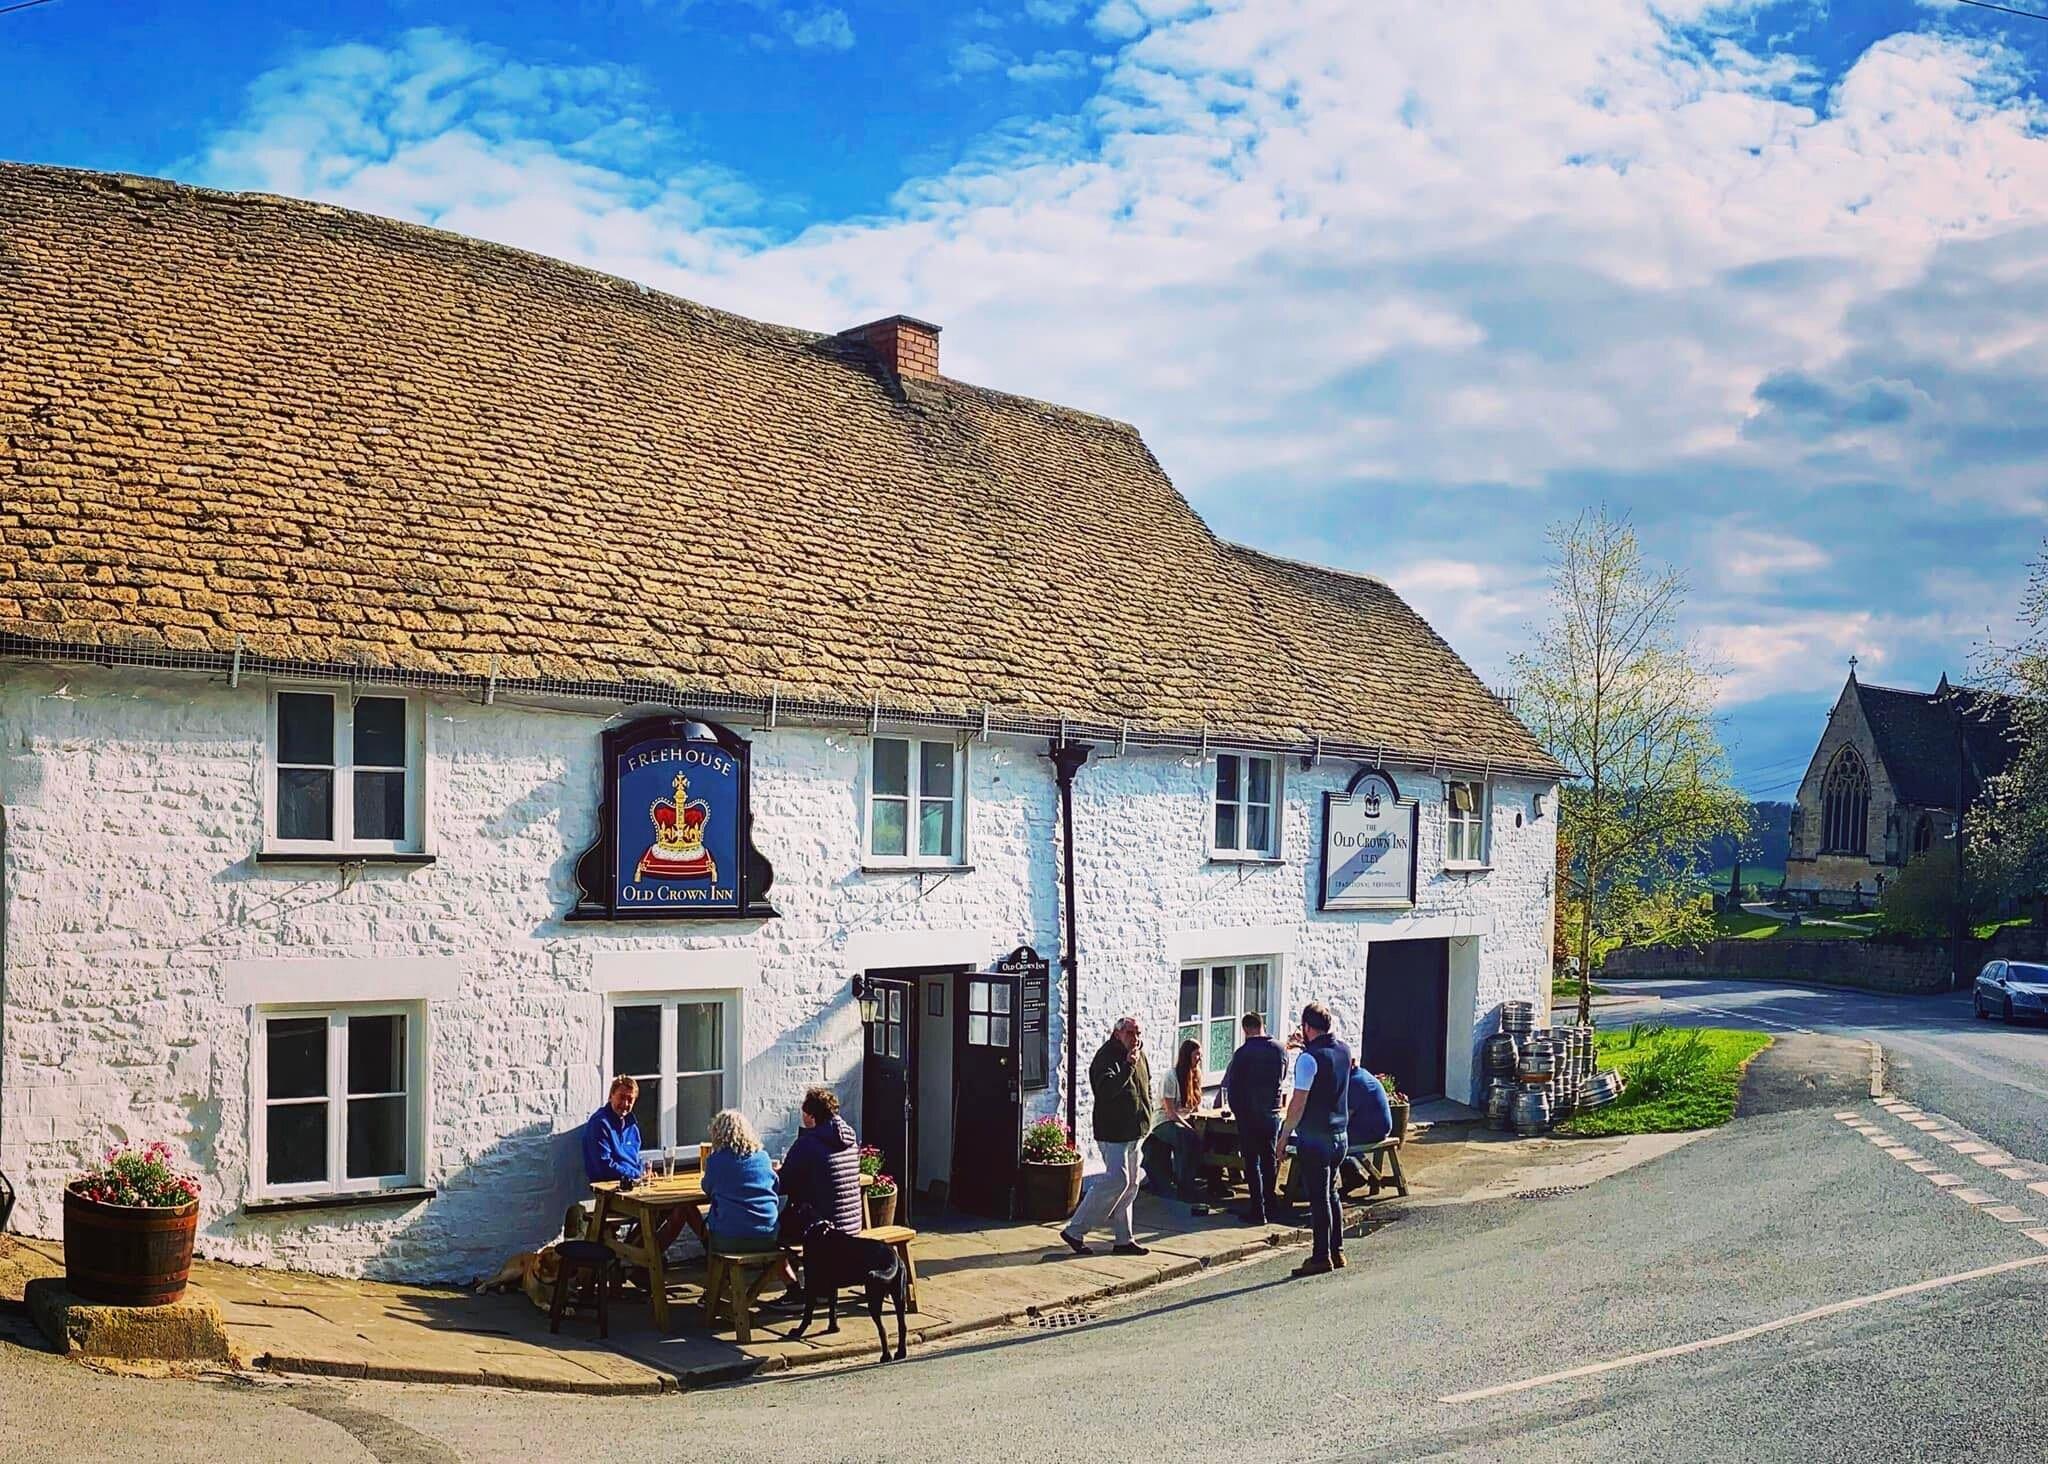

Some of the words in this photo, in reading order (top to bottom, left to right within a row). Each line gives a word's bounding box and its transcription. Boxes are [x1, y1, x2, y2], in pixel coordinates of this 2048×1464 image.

[628, 748, 732, 777] FREEHOUSE
[1333, 831, 1355, 847] OLD
[1357, 832, 1390, 848] CROWN
[1393, 833, 1408, 849] INN
[1361, 854, 1378, 864] ULEY
[622, 885, 654, 901] OLD
[657, 885, 707, 901] CROWN
[711, 885, 733, 901] INN
[1002, 962, 1015, 971] OLD
